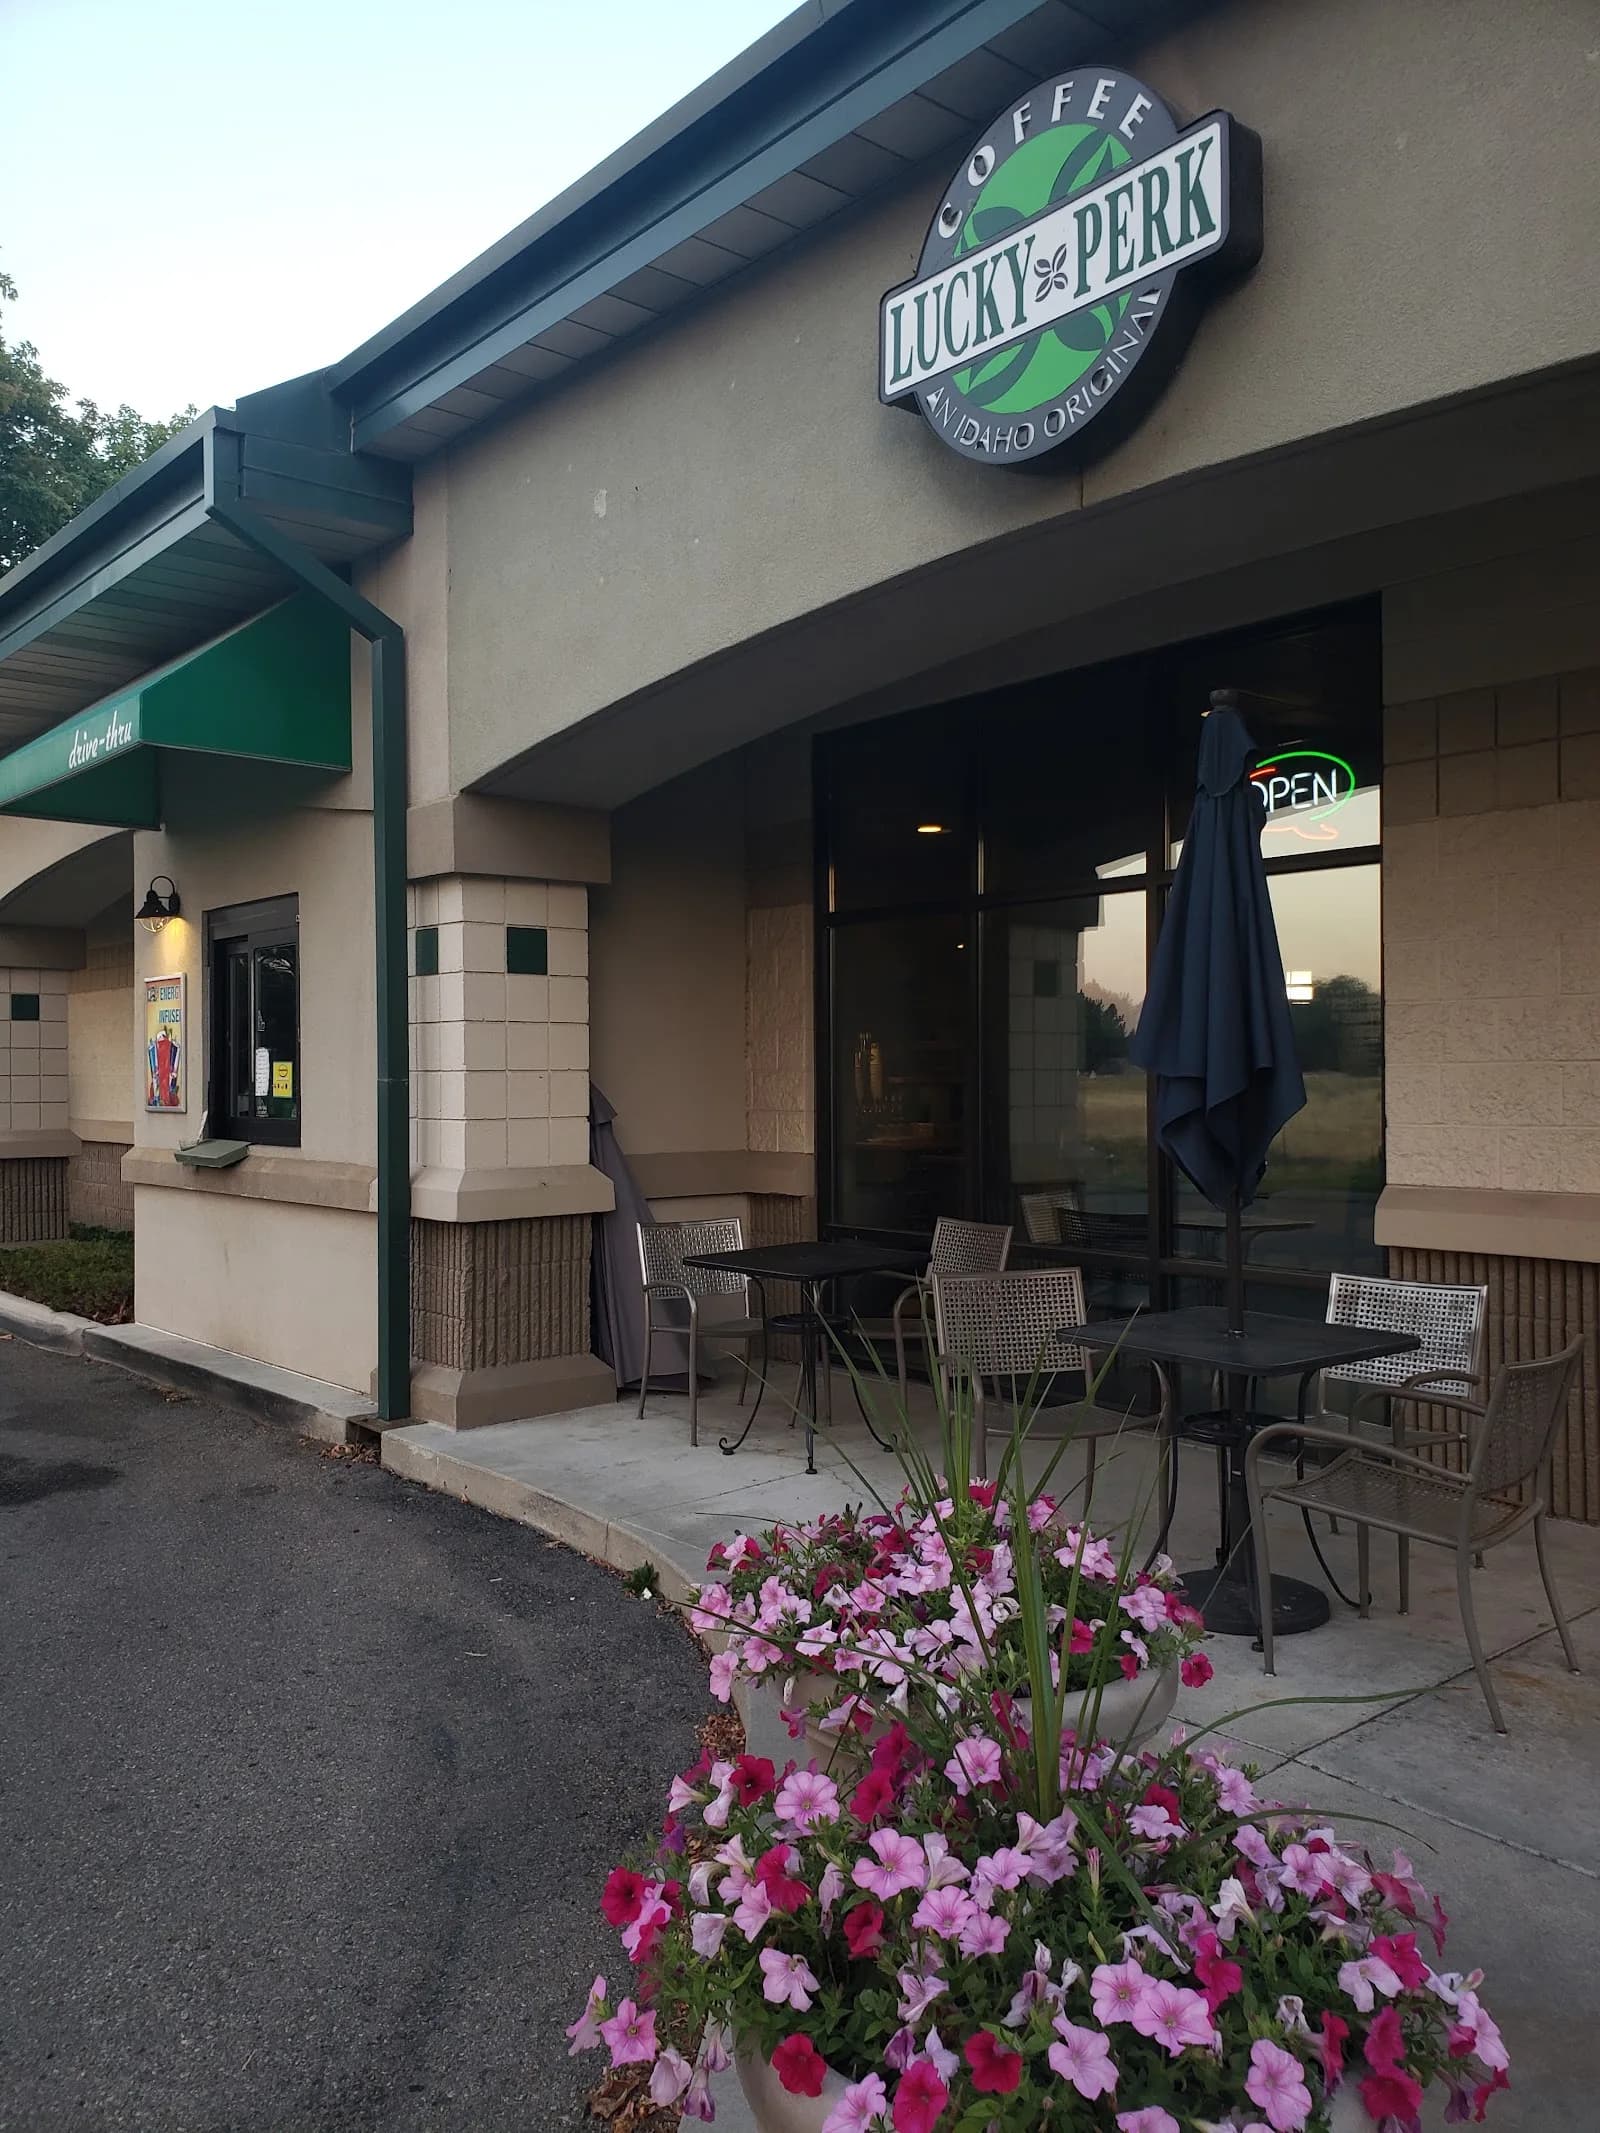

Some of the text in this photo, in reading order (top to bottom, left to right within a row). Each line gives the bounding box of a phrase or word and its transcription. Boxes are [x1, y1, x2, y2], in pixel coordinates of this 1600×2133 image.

[937, 78, 1152, 239] COFFEE
[889, 136, 1216, 386] LUCKY PERK
[926, 288, 1162, 454] AN IDAHO ORIGINAL
[68, 710, 132, 769] drive-thru
